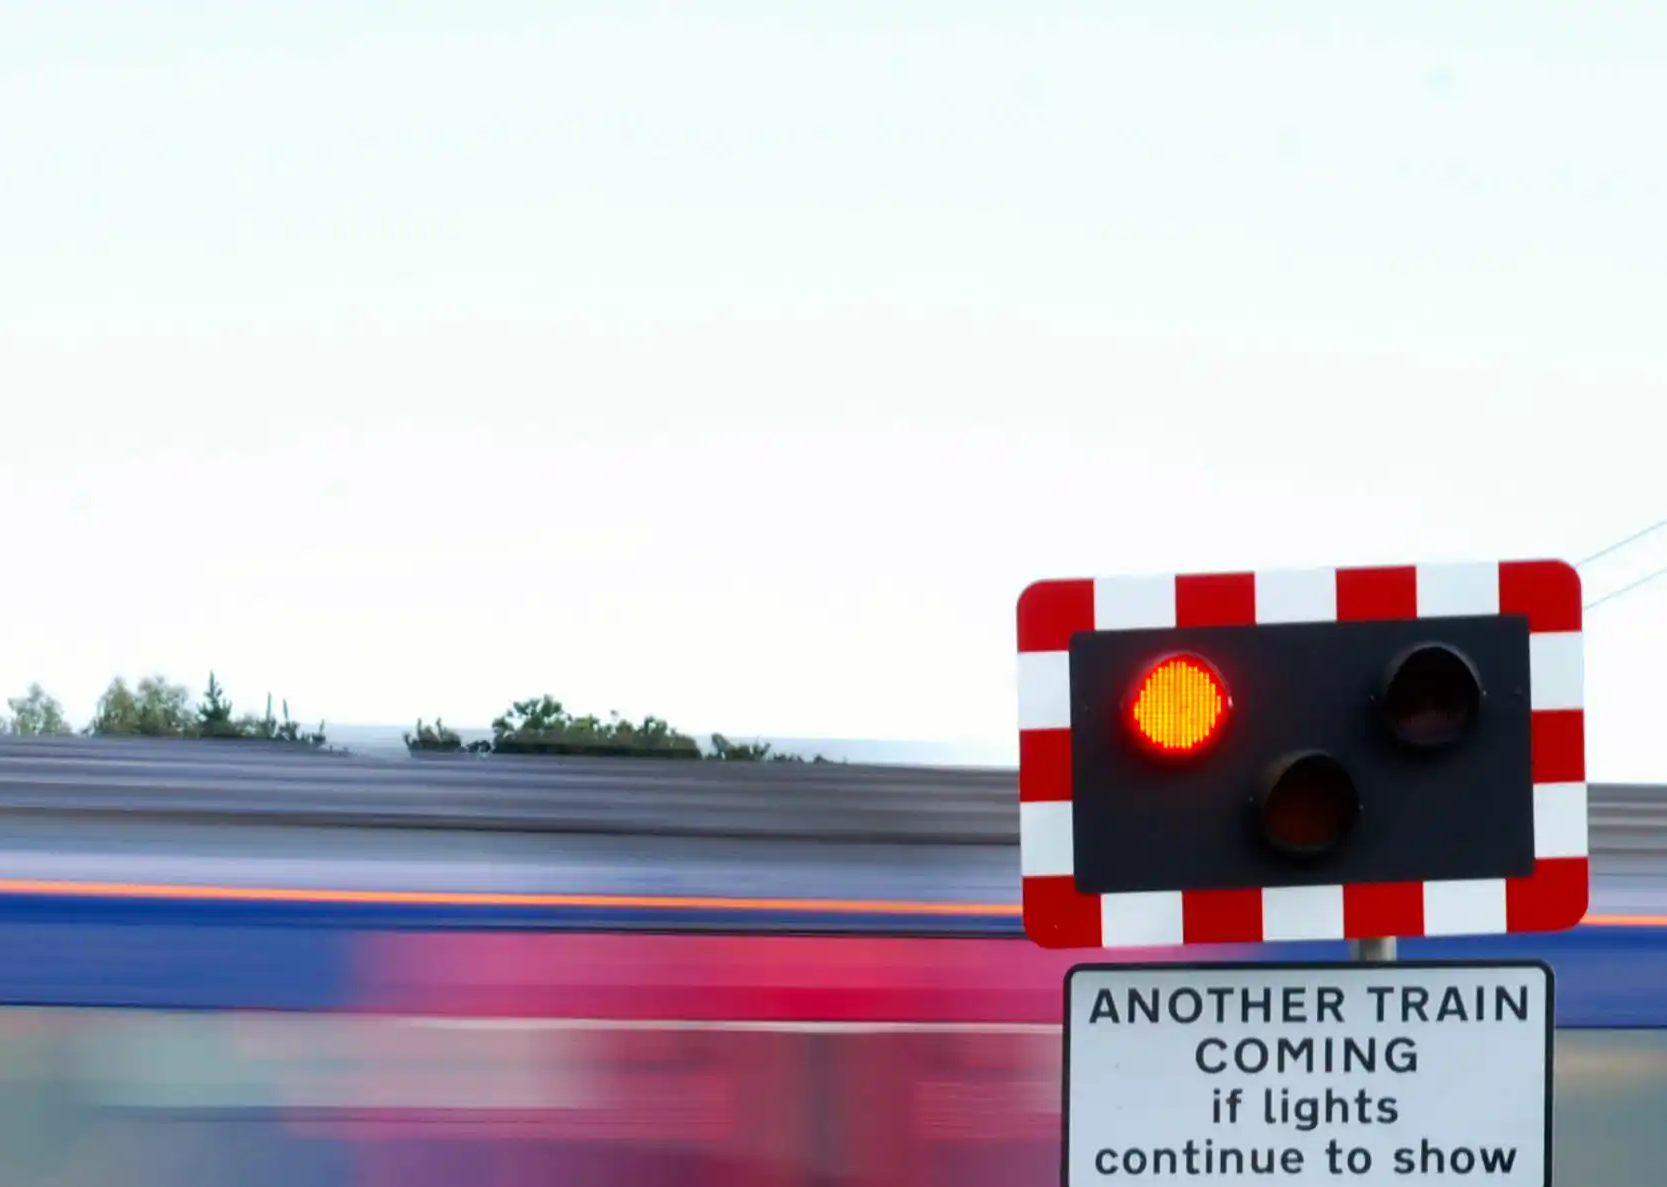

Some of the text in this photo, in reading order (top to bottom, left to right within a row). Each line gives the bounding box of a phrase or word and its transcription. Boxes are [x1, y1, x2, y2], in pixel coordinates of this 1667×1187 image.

[1088, 985, 1528, 1024] ANOTHER TRAIN
[1195, 1036, 1417, 1074] COMING
[1212, 1087, 1399, 1132] if lights
[1094, 1138, 1518, 1176] continue to show
